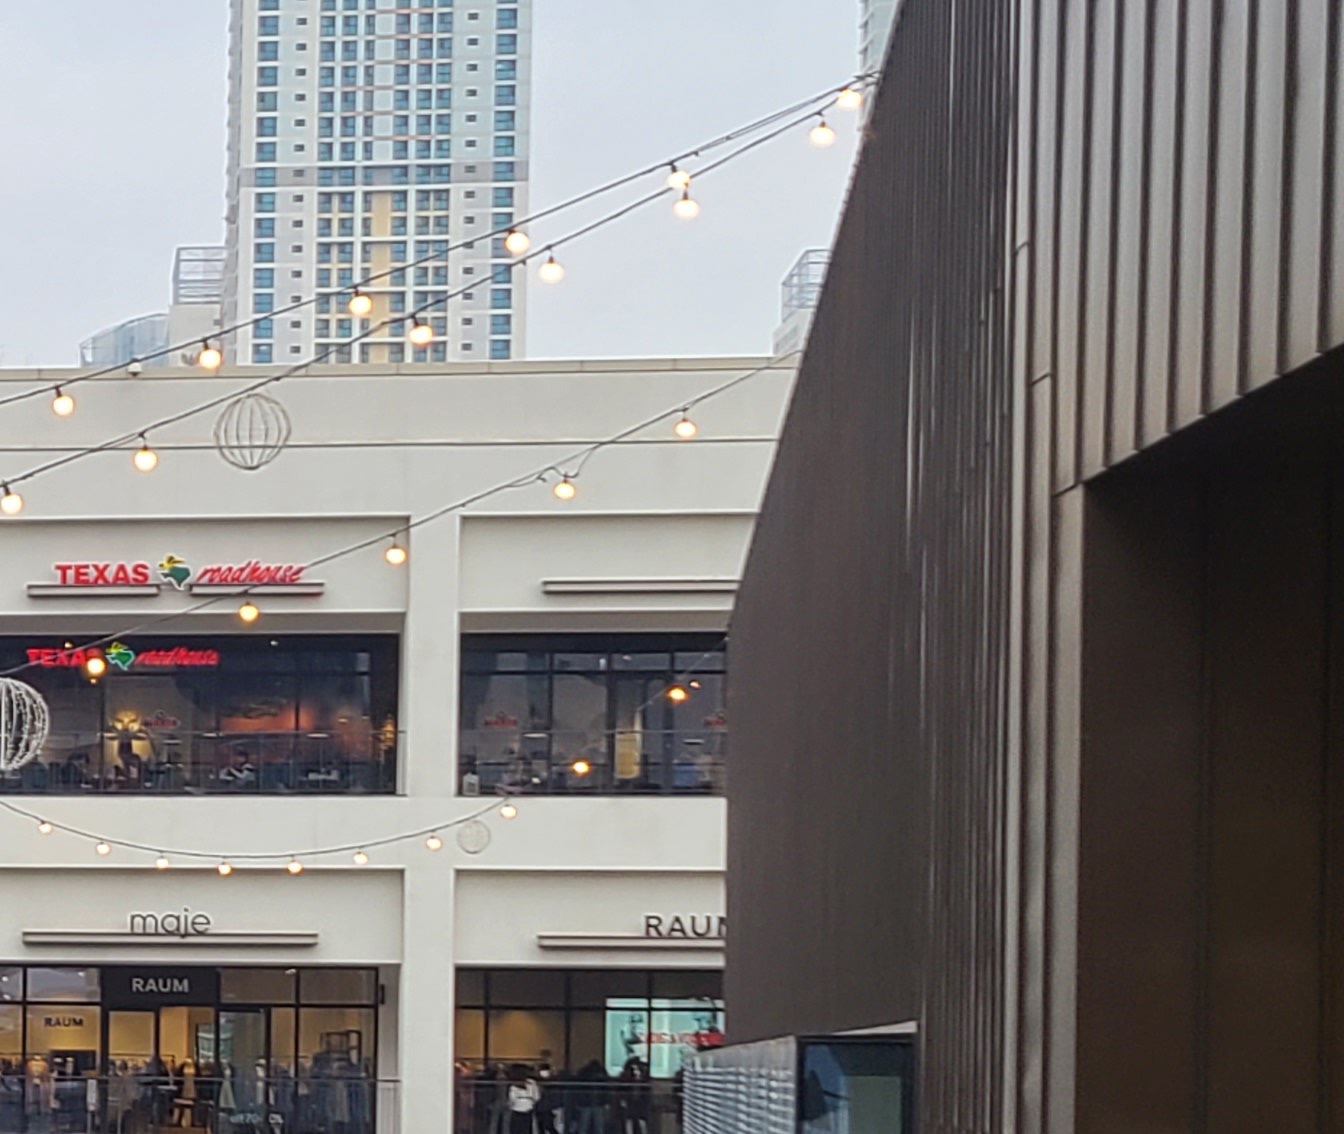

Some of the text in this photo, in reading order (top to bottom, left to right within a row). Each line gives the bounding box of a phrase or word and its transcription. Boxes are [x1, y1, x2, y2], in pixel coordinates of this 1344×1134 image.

[55, 560, 305, 585] TEXAS roadhouse
[129, 907, 211, 939] maje
[131, 977, 190, 993] RAUM
[44, 1016, 84, 1028] RAUM
